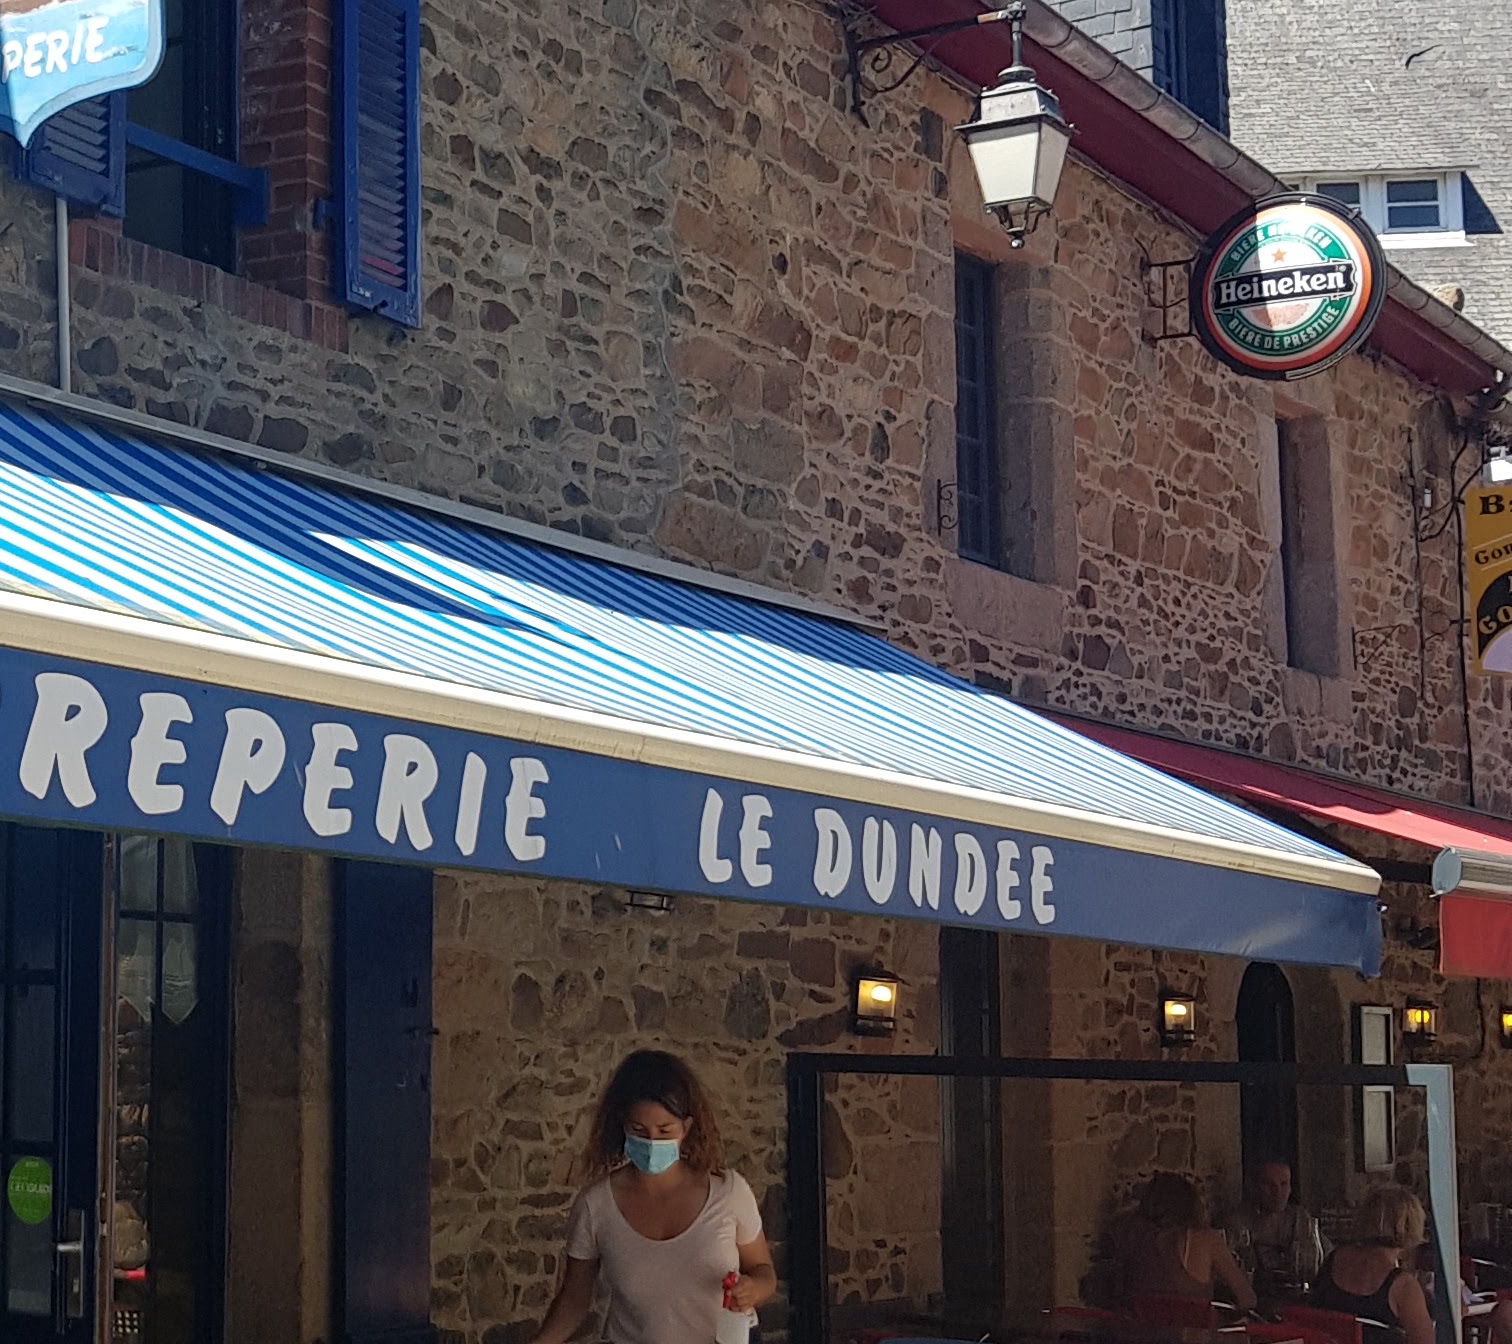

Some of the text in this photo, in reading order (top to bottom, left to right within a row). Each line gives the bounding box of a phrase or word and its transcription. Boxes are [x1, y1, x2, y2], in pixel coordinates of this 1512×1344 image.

[1219, 270, 1346, 305] Heineken
[1228, 307, 1340, 350] BIERE DE PRESTIGE
[699, 787, 1056, 925] LE DUNDEE
